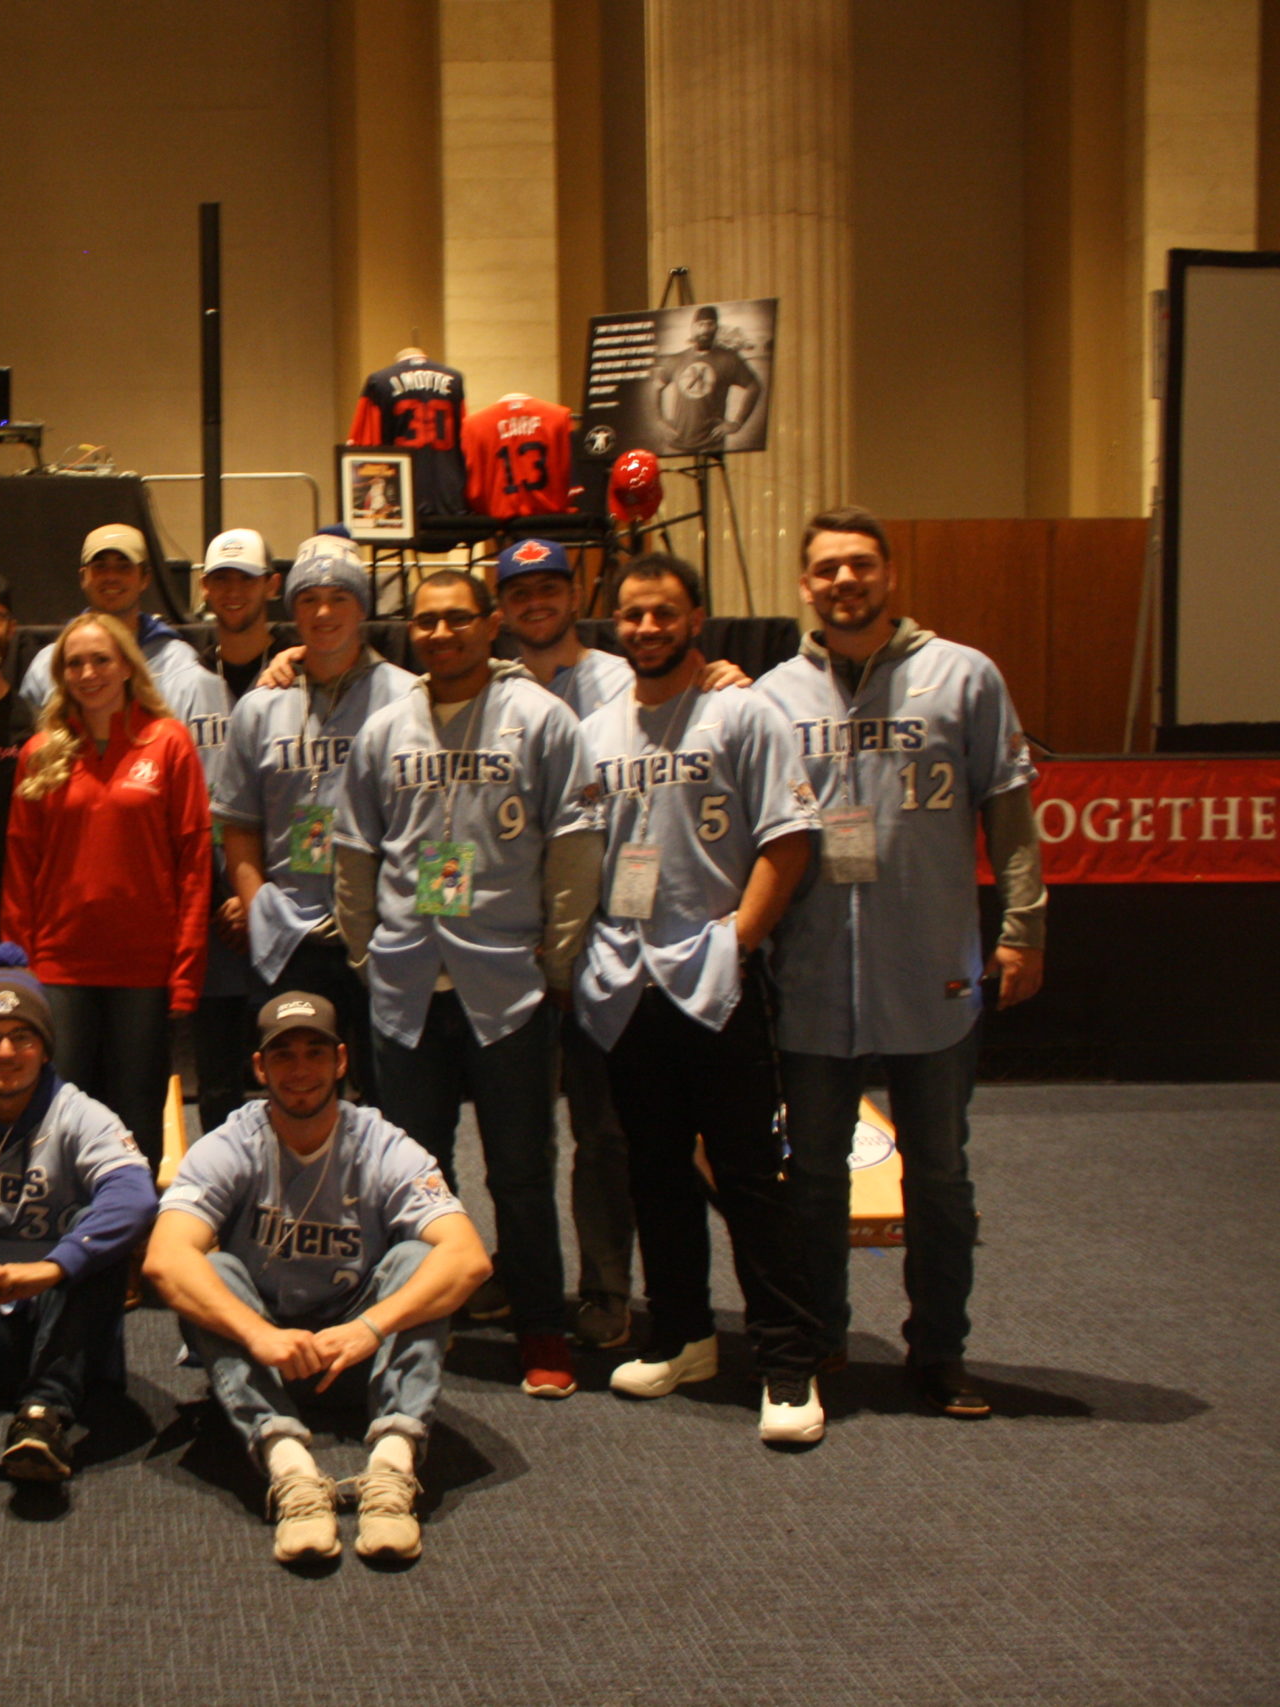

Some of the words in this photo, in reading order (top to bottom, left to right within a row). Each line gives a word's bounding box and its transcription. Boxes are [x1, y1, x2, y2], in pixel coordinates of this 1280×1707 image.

[393, 398, 455, 451] 30
[496, 442, 549, 494] 13
[793, 717, 927, 758] Tigers
[393, 749, 515, 791] Tigers
[594, 749, 712, 798] Tigers
[899, 762, 955, 810] 12
[498, 796, 526, 841] 9
[697, 794, 730, 842] 5
[249, 1204, 362, 1259] Tigers
